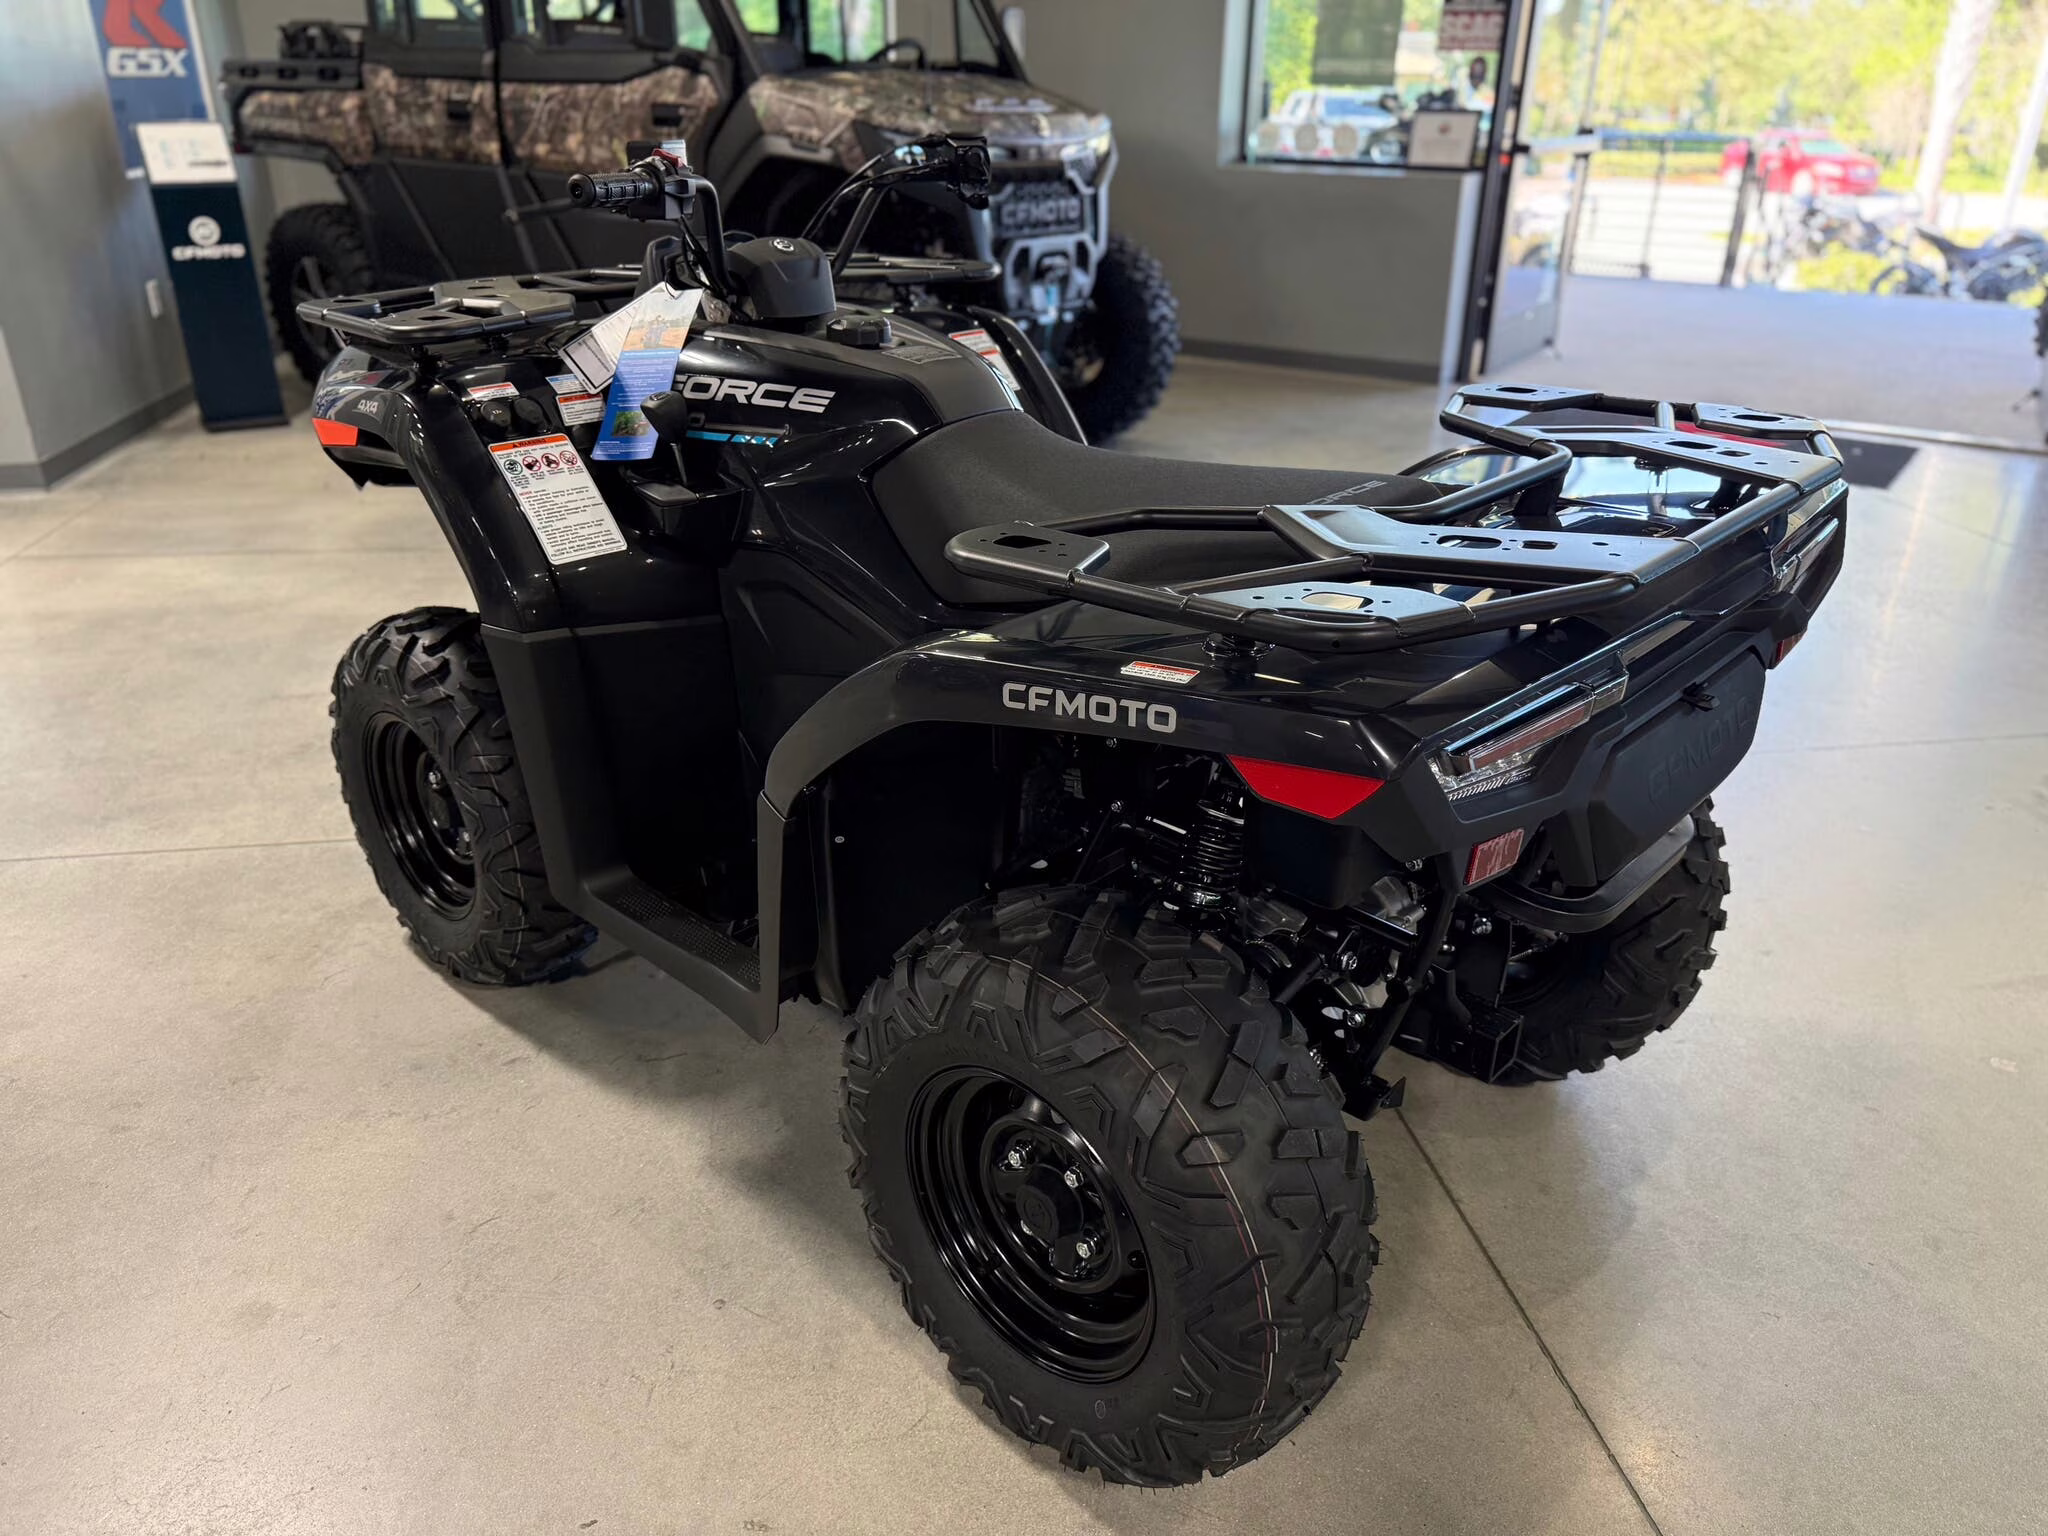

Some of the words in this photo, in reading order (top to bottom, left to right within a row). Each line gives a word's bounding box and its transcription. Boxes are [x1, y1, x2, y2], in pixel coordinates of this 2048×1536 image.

[107, 47, 187, 77] GSX
[357, 400, 379, 414] 4X4
[1002, 682, 1177, 733] CFMOTO
